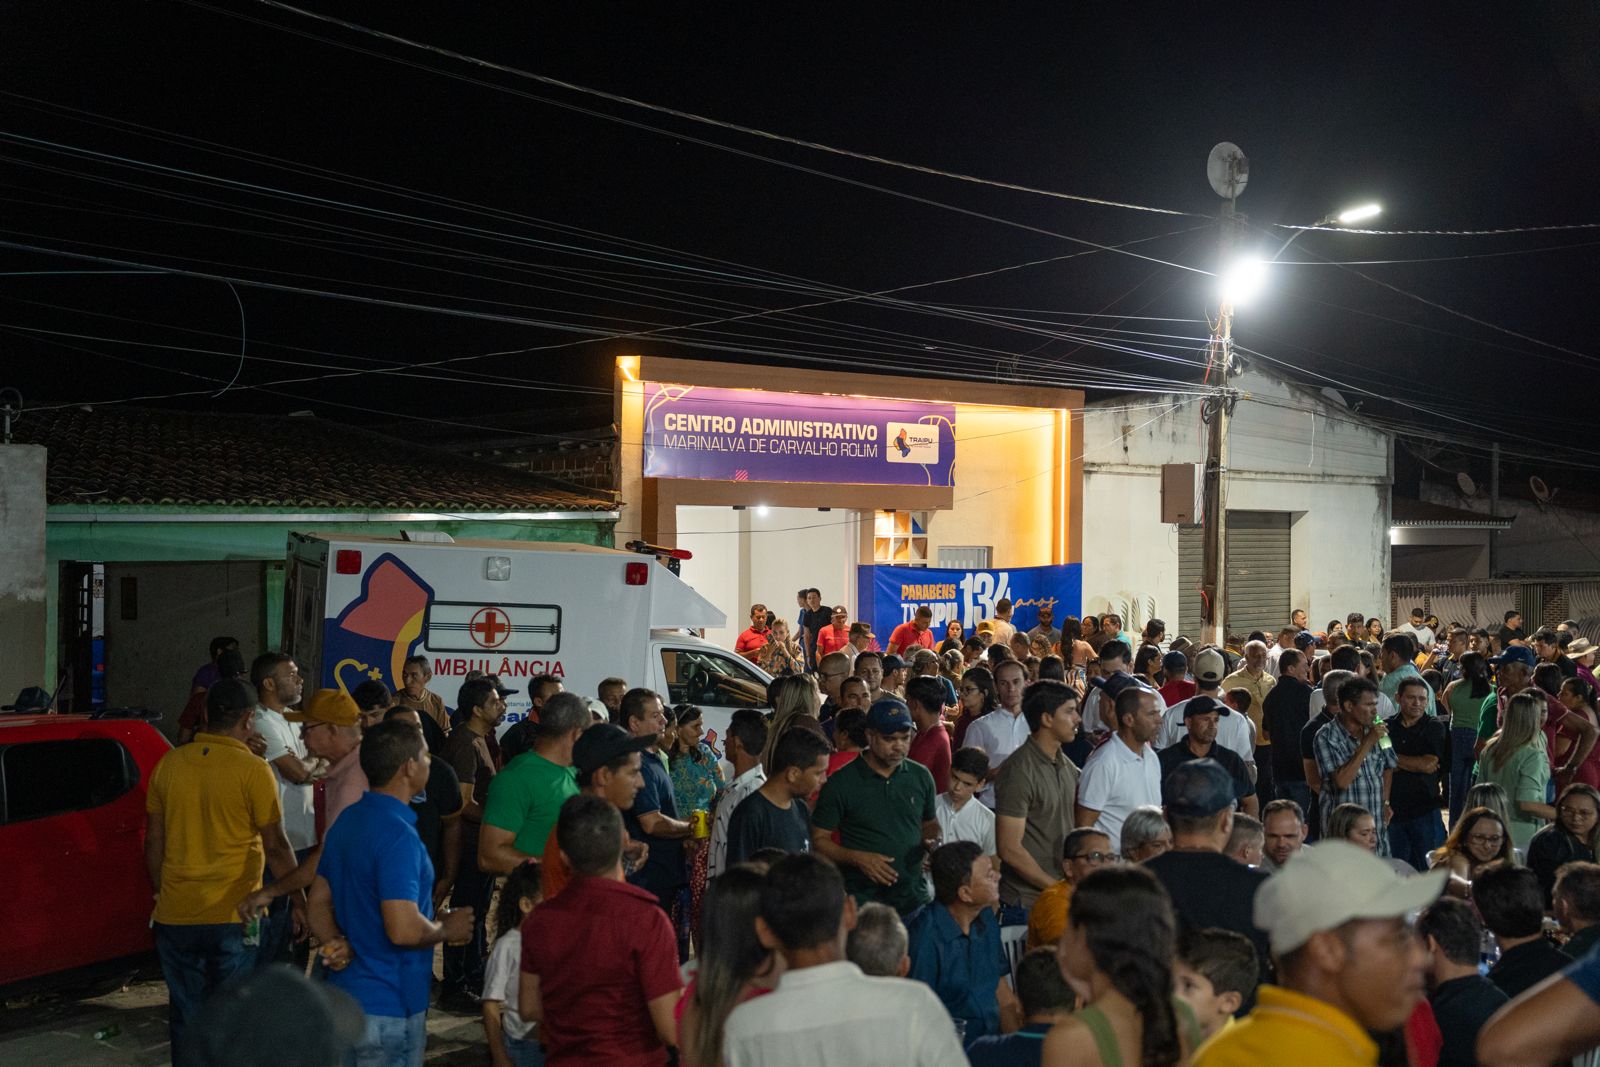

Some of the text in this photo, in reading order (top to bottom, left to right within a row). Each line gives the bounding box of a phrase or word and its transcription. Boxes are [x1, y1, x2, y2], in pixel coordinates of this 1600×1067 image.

[664, 413, 878, 441] CENTRO ADMINISTRATIVO
[663, 433, 878, 458] MARINALVA DE CARVALHO ROLIM
[901, 582, 957, 600] PARABÉNS
[434, 657, 566, 677] MBULÂNCIA
